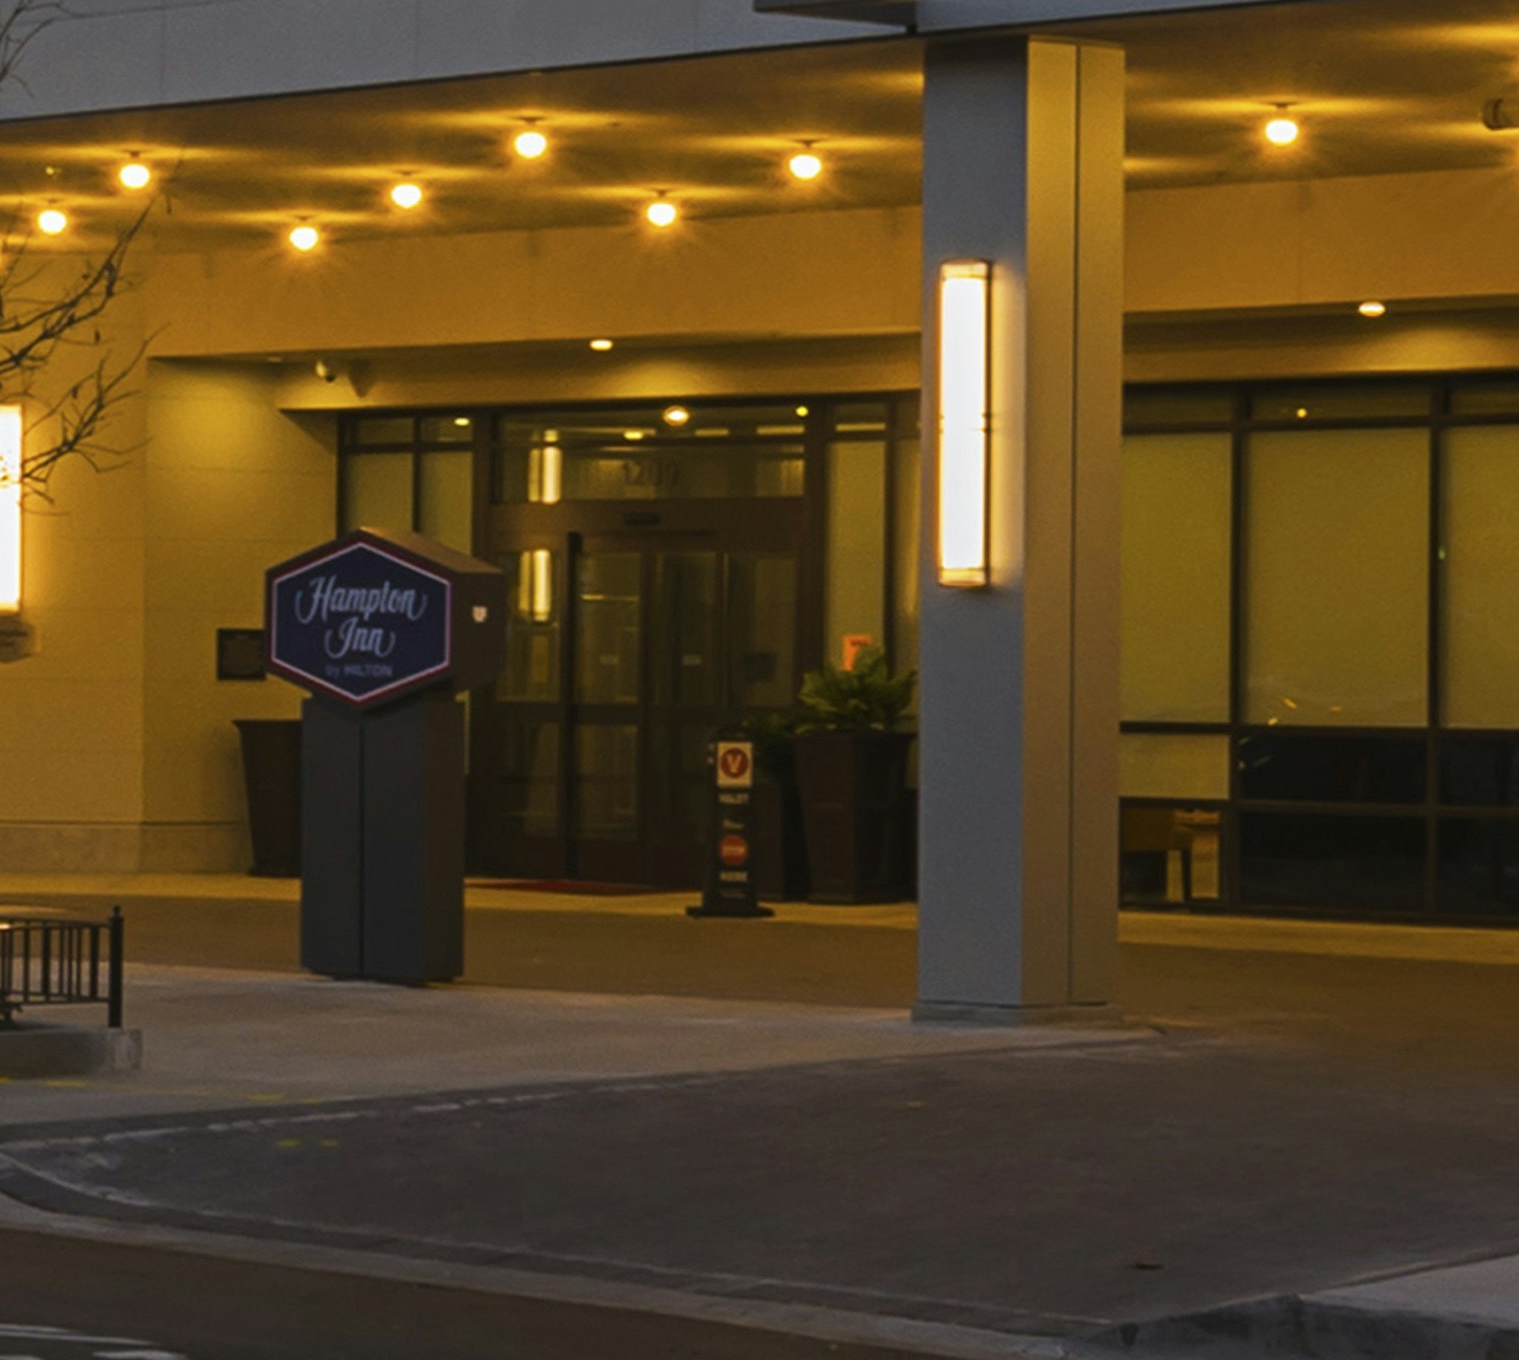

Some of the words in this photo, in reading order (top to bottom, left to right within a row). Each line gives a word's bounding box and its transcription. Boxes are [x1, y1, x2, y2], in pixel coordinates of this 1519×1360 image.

[294, 575, 428, 624] Hampton
[324, 616, 396, 659] Inn
[343, 664, 393, 677] HILTON
